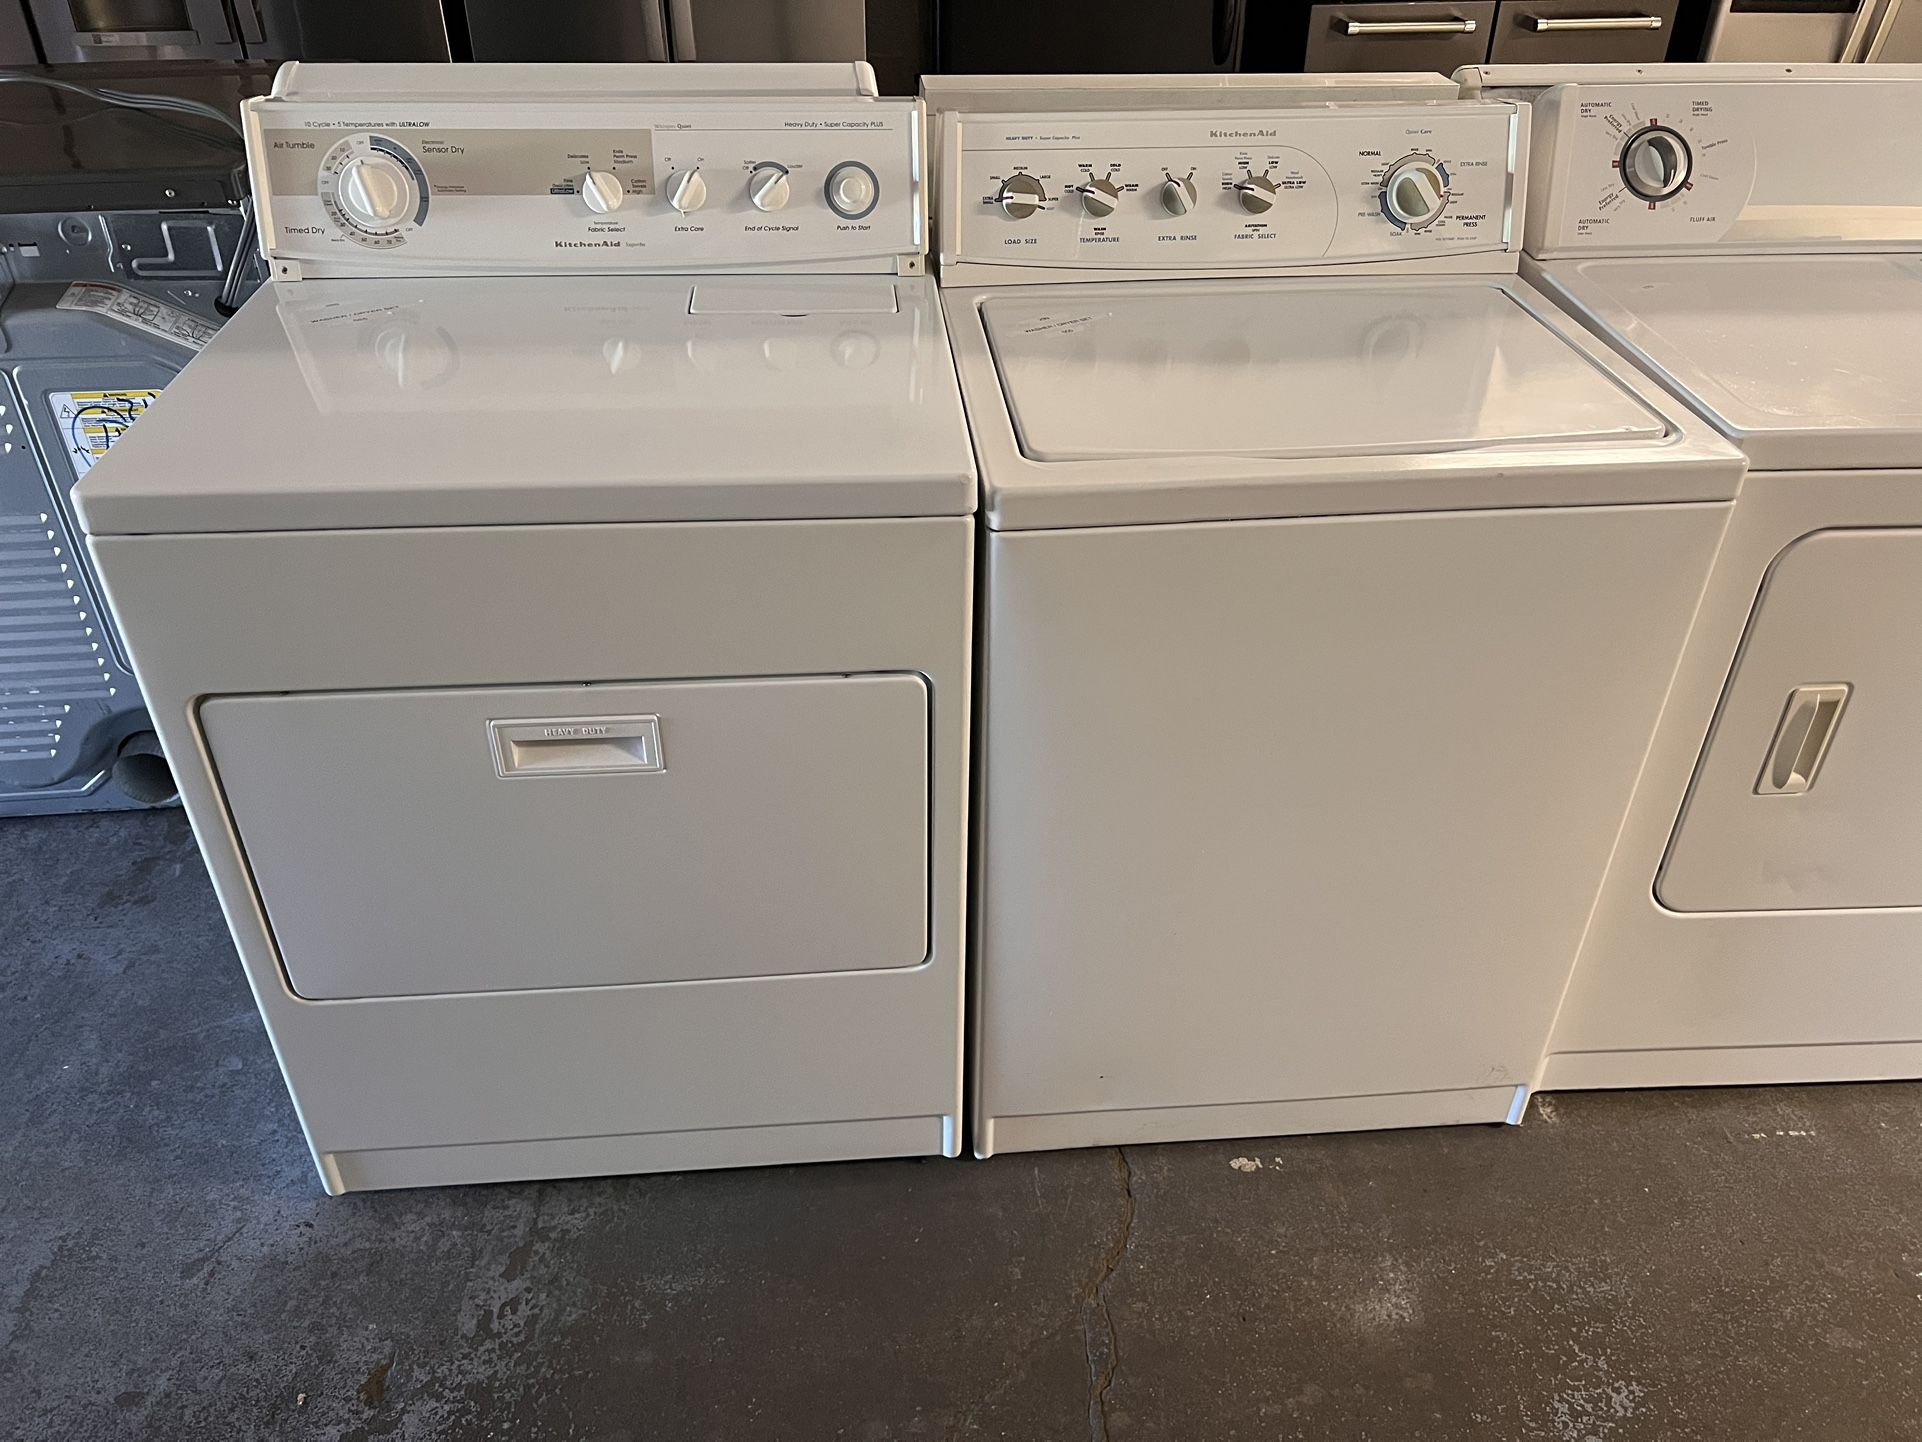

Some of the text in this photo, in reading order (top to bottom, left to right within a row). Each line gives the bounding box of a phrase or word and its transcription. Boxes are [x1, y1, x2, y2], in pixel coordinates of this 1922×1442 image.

[1609, 114, 1622, 128] Energy
[1209, 130, 1277, 138] KitchenAid
[273, 141, 315, 149] Air Tumble
[423, 145, 464, 154] Sensor Dry
[285, 226, 325, 235] Timed Dry
[554, 240, 621, 248] KitchenAid
[544, 727, 607, 736] HEAVY DUTY
